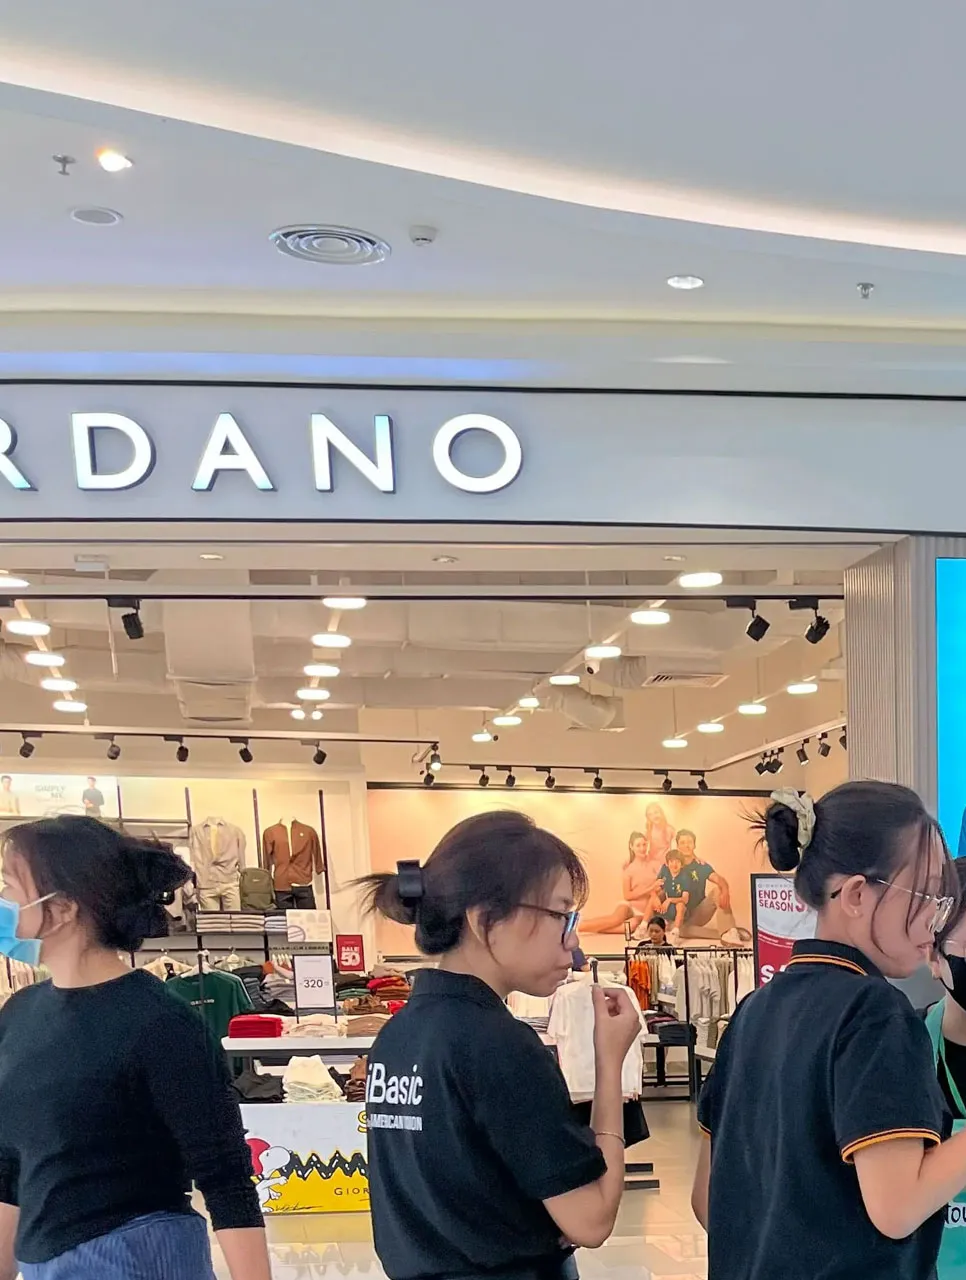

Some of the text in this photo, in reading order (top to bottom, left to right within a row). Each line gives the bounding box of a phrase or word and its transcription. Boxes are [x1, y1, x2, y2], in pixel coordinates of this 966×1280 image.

[758, 890, 778, 900] END
[779, 890, 793, 901] OF
[758, 899, 794, 912] SEASON
[303, 979, 323, 988] 320
[366, 1063, 423, 1105] iBasic
